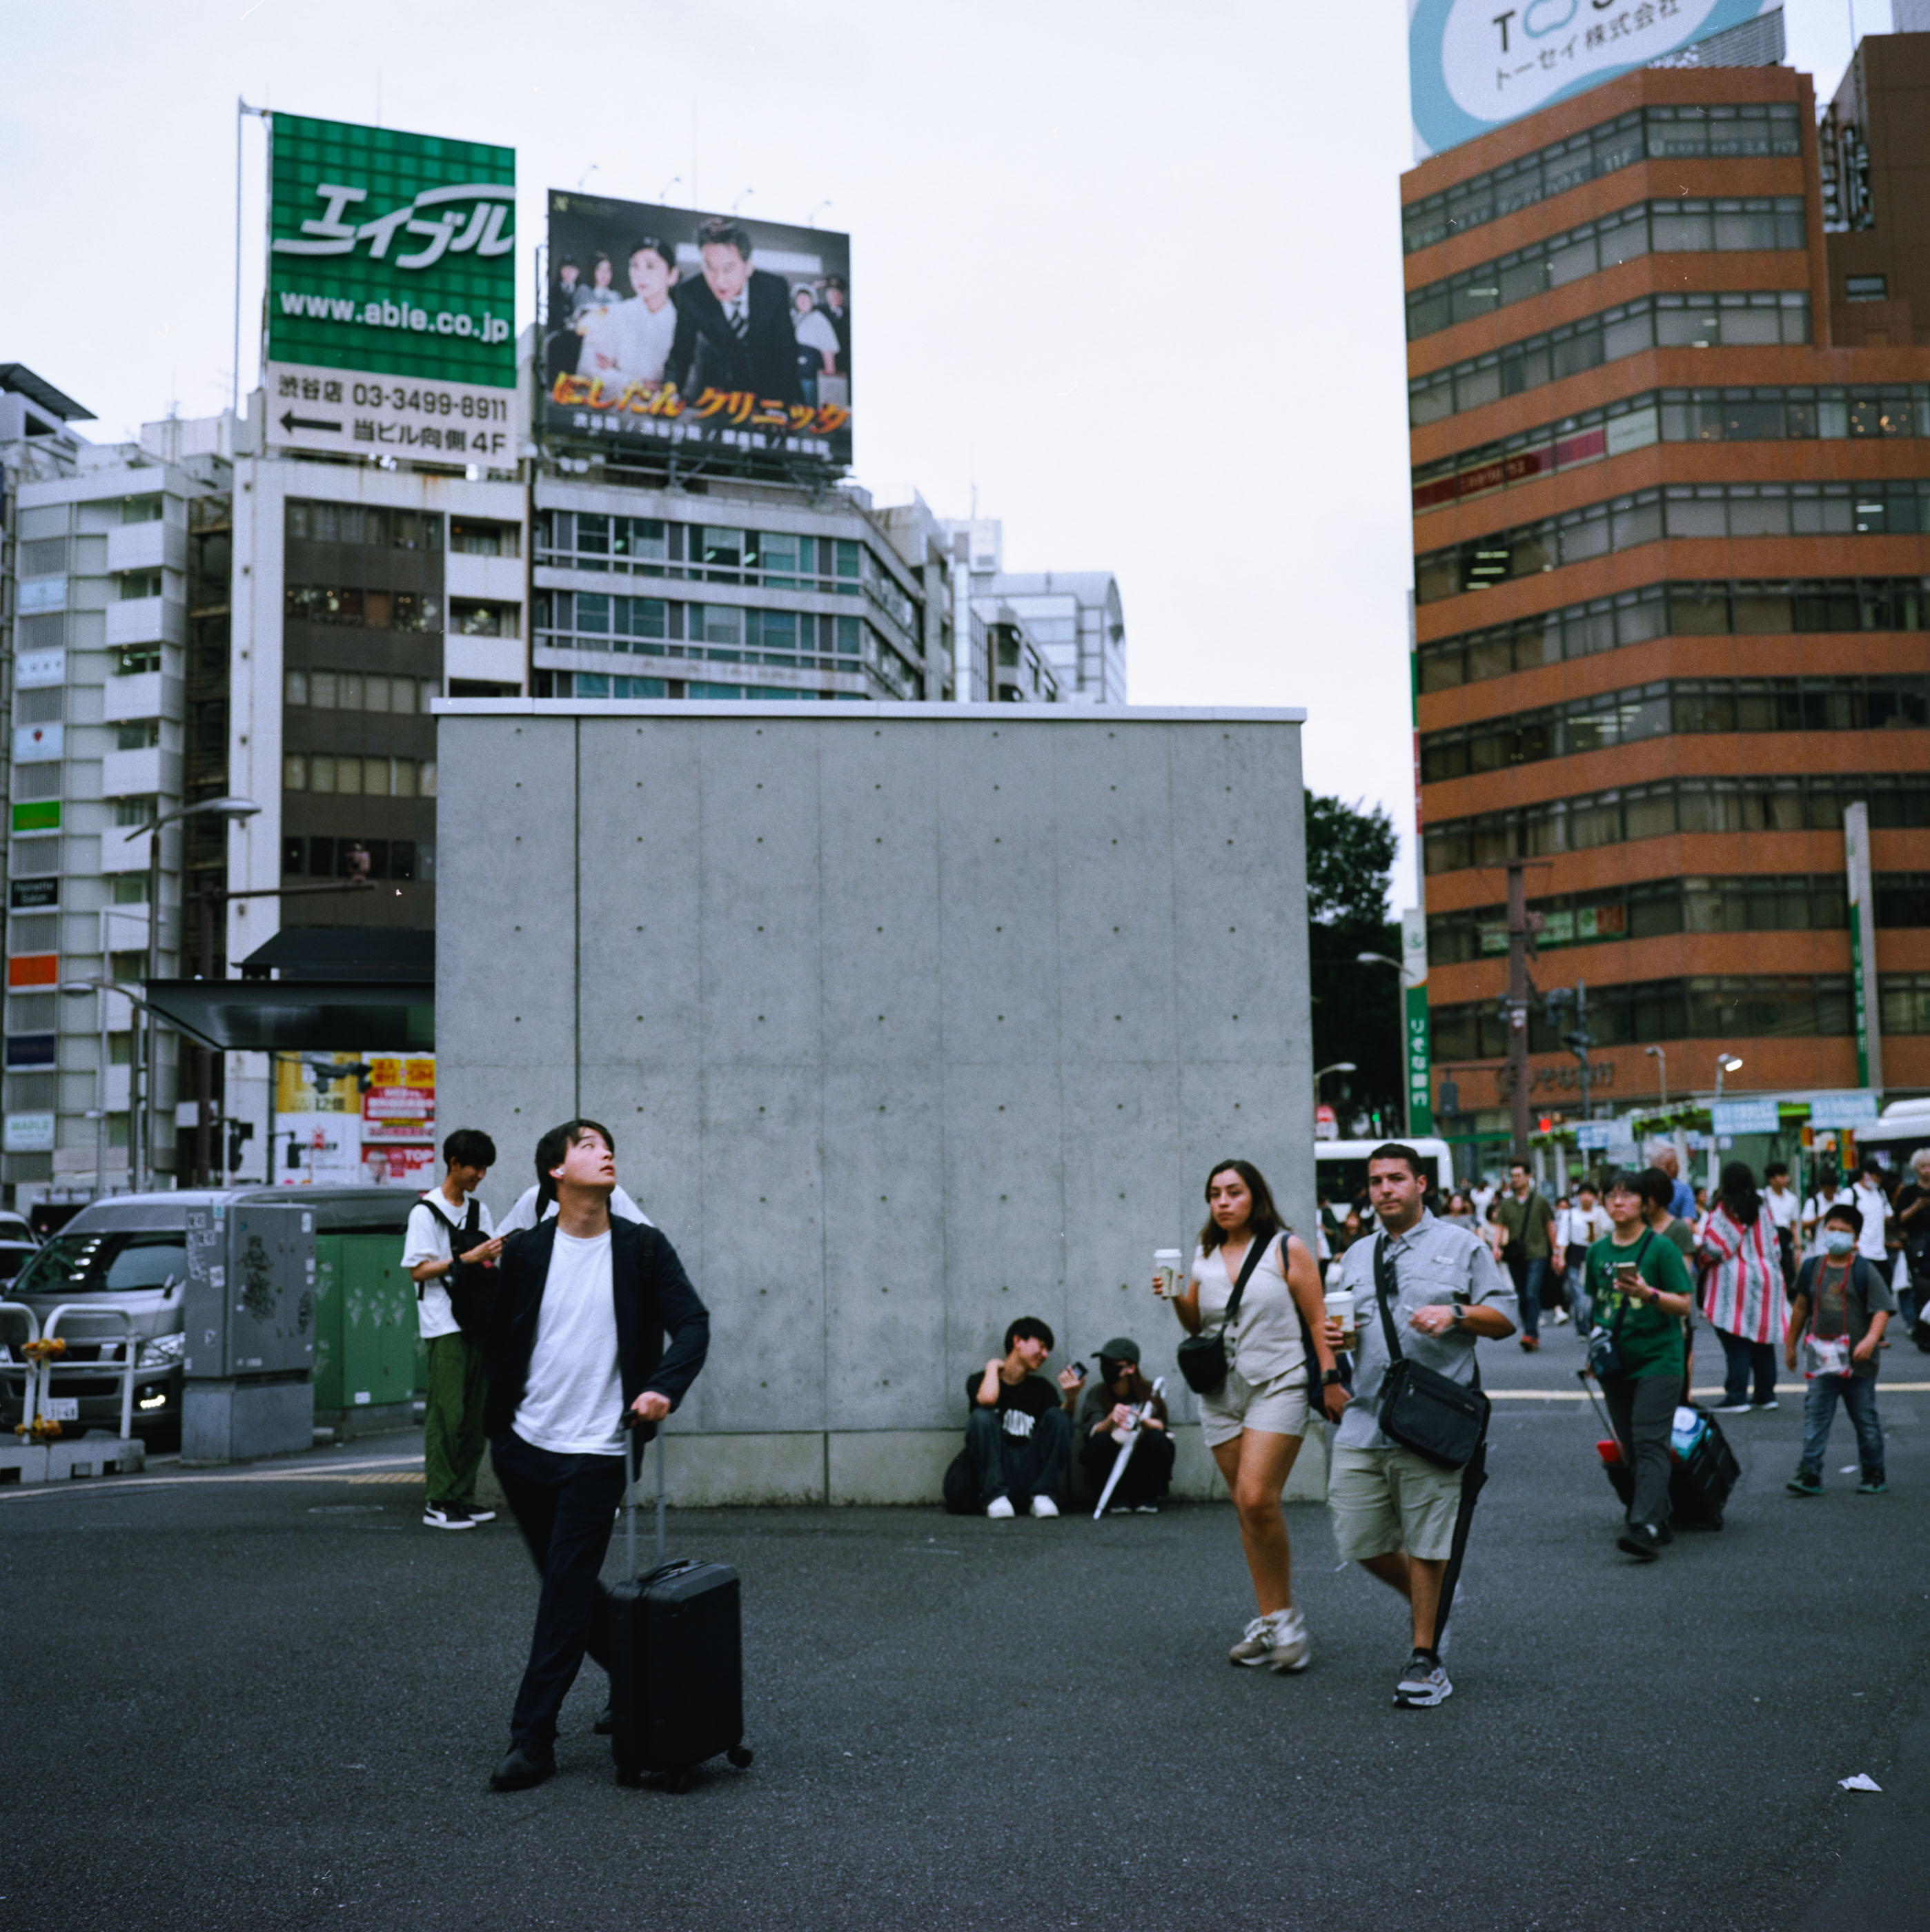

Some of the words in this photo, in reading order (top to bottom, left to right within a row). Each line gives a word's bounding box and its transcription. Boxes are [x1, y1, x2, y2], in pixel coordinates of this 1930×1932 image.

[272, 183, 515, 269] エイブル
[281, 291, 509, 344] www.able.co.jp
[279, 375, 342, 402] 渋谷店
[353, 383, 507, 422] 03-3499-8911
[552, 371, 687, 417] にしたん
[694, 386, 851, 434] クリニック
